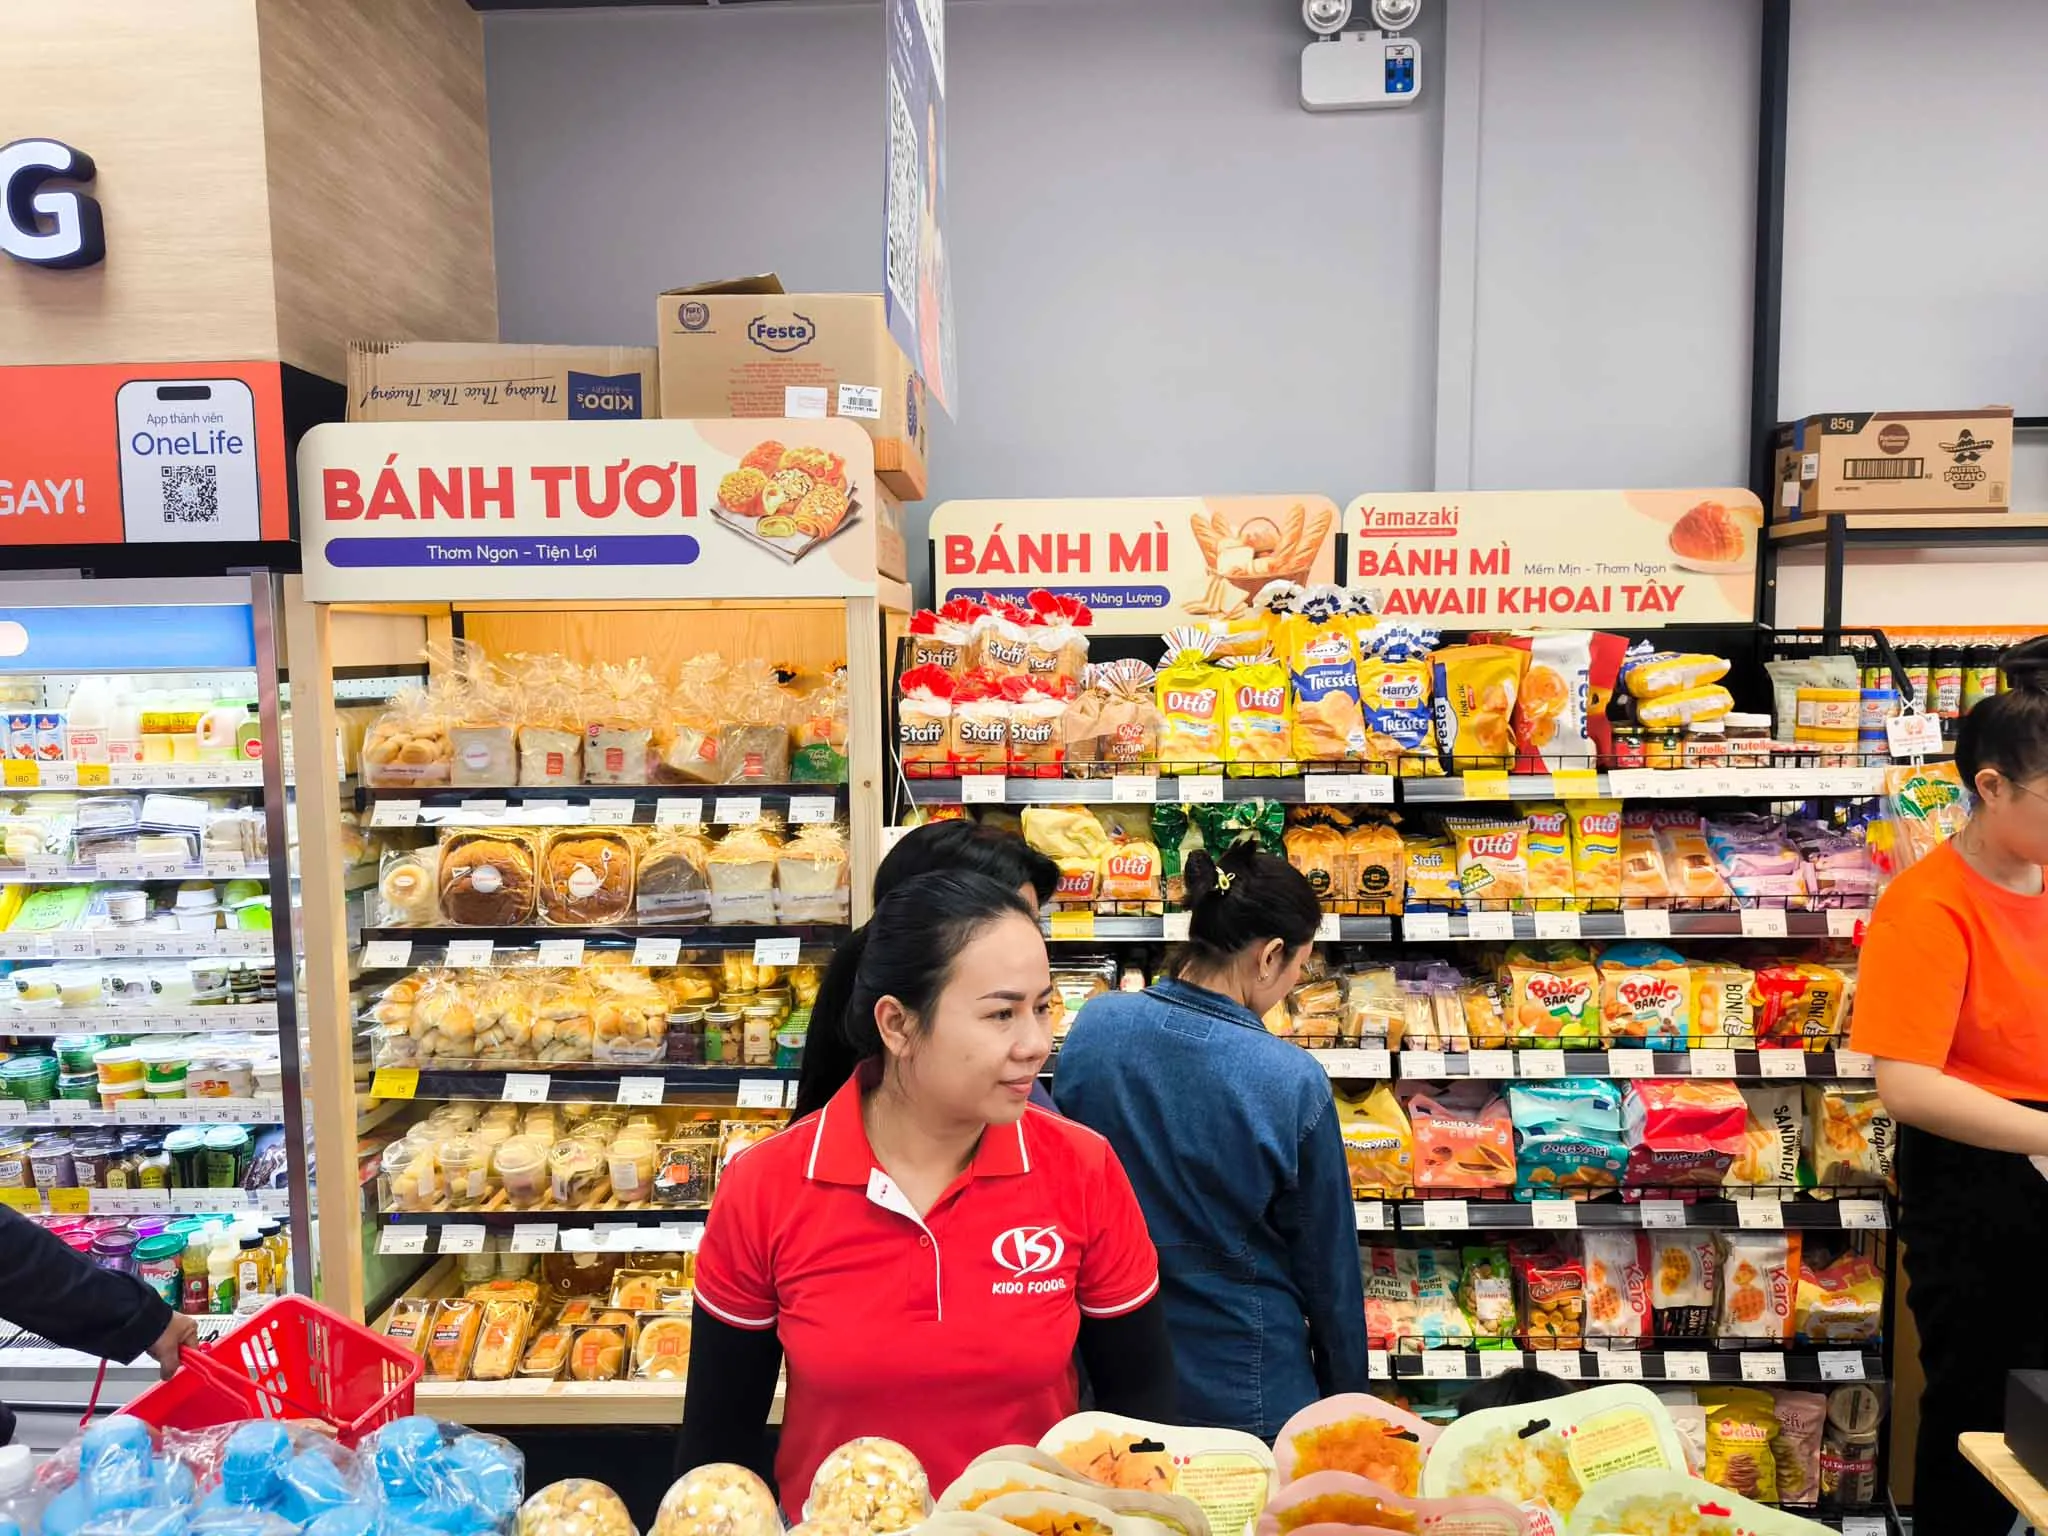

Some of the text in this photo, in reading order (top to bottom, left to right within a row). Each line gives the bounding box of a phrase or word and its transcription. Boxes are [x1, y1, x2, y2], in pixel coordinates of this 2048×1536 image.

[756, 324, 807, 339] Festa
[147, 412, 223, 425] App thành viên
[1830, 417, 1855, 433] 85g
[132, 430, 244, 456] OneLife
[1944, 470, 1986, 482] POTATO
[323, 453, 698, 521] BÁNH TƯƠI
[1361, 506, 1460, 527] Yamazaki
[426, 544, 473, 560] Thơm
[476, 545, 519, 566] Ngon
[535, 544, 576, 561] Tiện
[580, 544, 598, 563] Lợi
[944, 520, 1169, 575] BÁNH MÌ
[1358, 540, 1511, 577] BÁNH MÌ
[1524, 562, 1555, 575] Mềm
[1560, 563, 1581, 577] Mịn
[1595, 562, 1631, 575] Thơm
[1634, 562, 1667, 578] Ngon
[1091, 592, 1122, 606] Năng
[1126, 592, 1163, 609] Lượng
[1380, 579, 1684, 615] AWAII KHOAI TÂY
[916, 648, 958, 667] Staff
[988, 641, 1028, 666] Staff
[1168, 689, 1217, 713] Otto
[1240, 686, 1285, 709] Otto
[900, 721, 945, 744] Staff
[961, 721, 1007, 744] Staff
[1011, 721, 1054, 743] Staff
[1688, 741, 1727, 754] nutella
[14, 774, 30, 784] 180
[55, 773, 70, 783] 159
[815, 809, 825, 818] 15
[1582, 814, 1617, 833] Otto
[1472, 834, 1514, 855] Otto
[1111, 857, 1157, 876] Otto
[1412, 854, 1443, 866] Staff
[47, 867, 58, 876] 23
[119, 866, 129, 875] 25
[164, 864, 176, 873] 20
[73, 943, 84, 952] 23
[114, 943, 126, 952] 29
[155, 942, 166, 952] 25
[1619, 979, 1680, 1004] BONG
[1543, 994, 1577, 1008] BANG
[1633, 996, 1668, 1011] BANG
[1715, 1064, 1727, 1072] 22
[1785, 1063, 1796, 1072] 22
[1860, 1063, 1873, 1072] 22
[1774, 1104, 1795, 1183] SANDWICH
[1867, 1116, 1892, 1178] Baguette
[112, 1201, 121, 1210] 16
[1864, 1214, 1876, 1223] 34
[463, 1239, 474, 1248] 25
[535, 1239, 547, 1248] 25
[1695, 1243, 1715, 1291] Karo
[992, 1280, 1025, 1295] KIDO
[1623, 1262, 1646, 1314] Karo
[1767, 1263, 1790, 1318] Karo
[1446, 1364, 1457, 1373] 24
[1765, 1366, 1777, 1375] 38
[1844, 1365, 1856, 1374] 25
